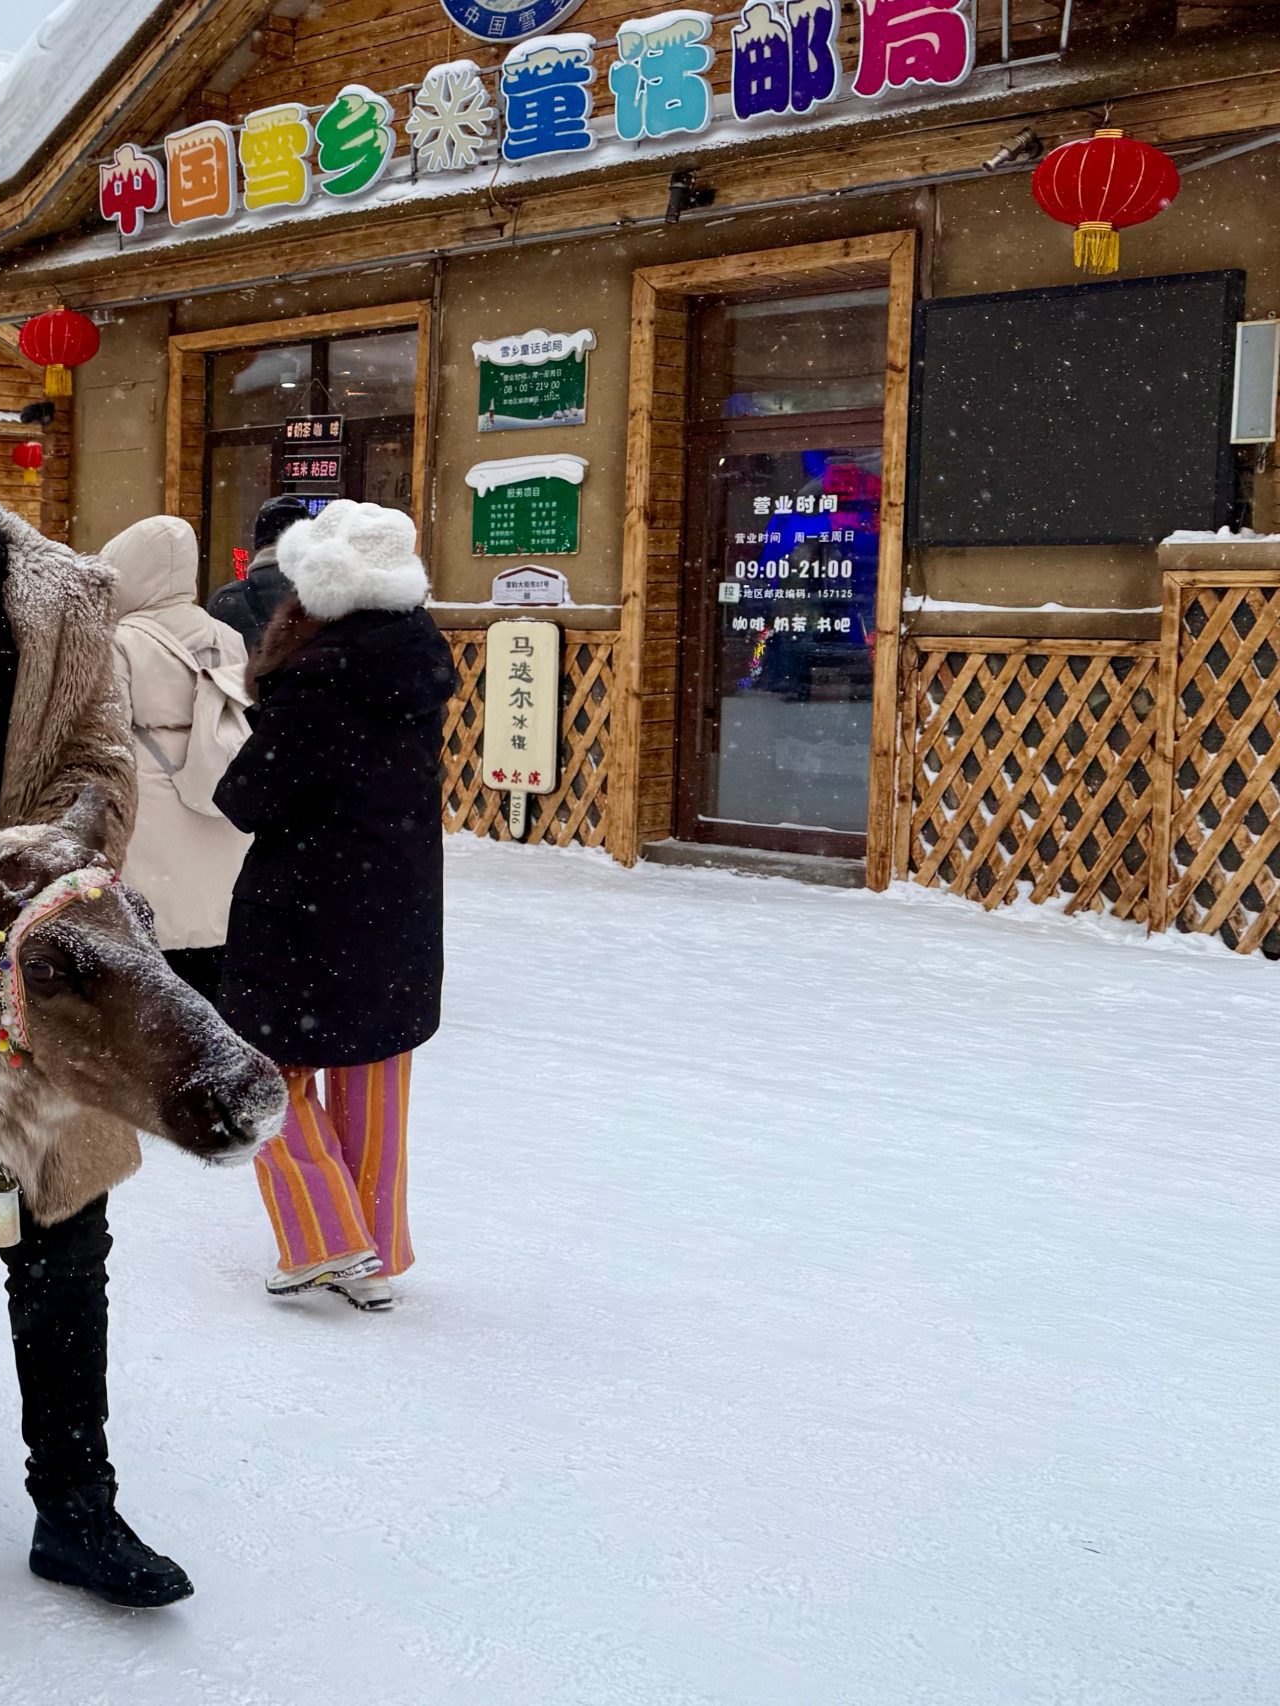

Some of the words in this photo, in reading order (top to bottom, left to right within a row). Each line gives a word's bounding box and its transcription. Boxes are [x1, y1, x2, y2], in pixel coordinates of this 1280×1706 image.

[100, 88, 393, 236] 中国雪乡
[501, 0, 973, 161] 童话邮局
[500, 340, 563, 358] 雪乡童话邮局
[753, 494, 838, 515] 营业时间
[735, 532, 781, 544] 营业时间
[794, 530, 855, 543] 周一至周日
[735, 560, 853, 579] 09:00-21:00
[724, 585, 734, 598] 拉
[739, 588, 853, 599] 地区邮政编码：157125
[732, 616, 765, 632] 咖啡
[773, 616, 807, 632] 奶茶
[817, 616, 851, 632] 书吧
[511, 796, 522, 824] 1906
